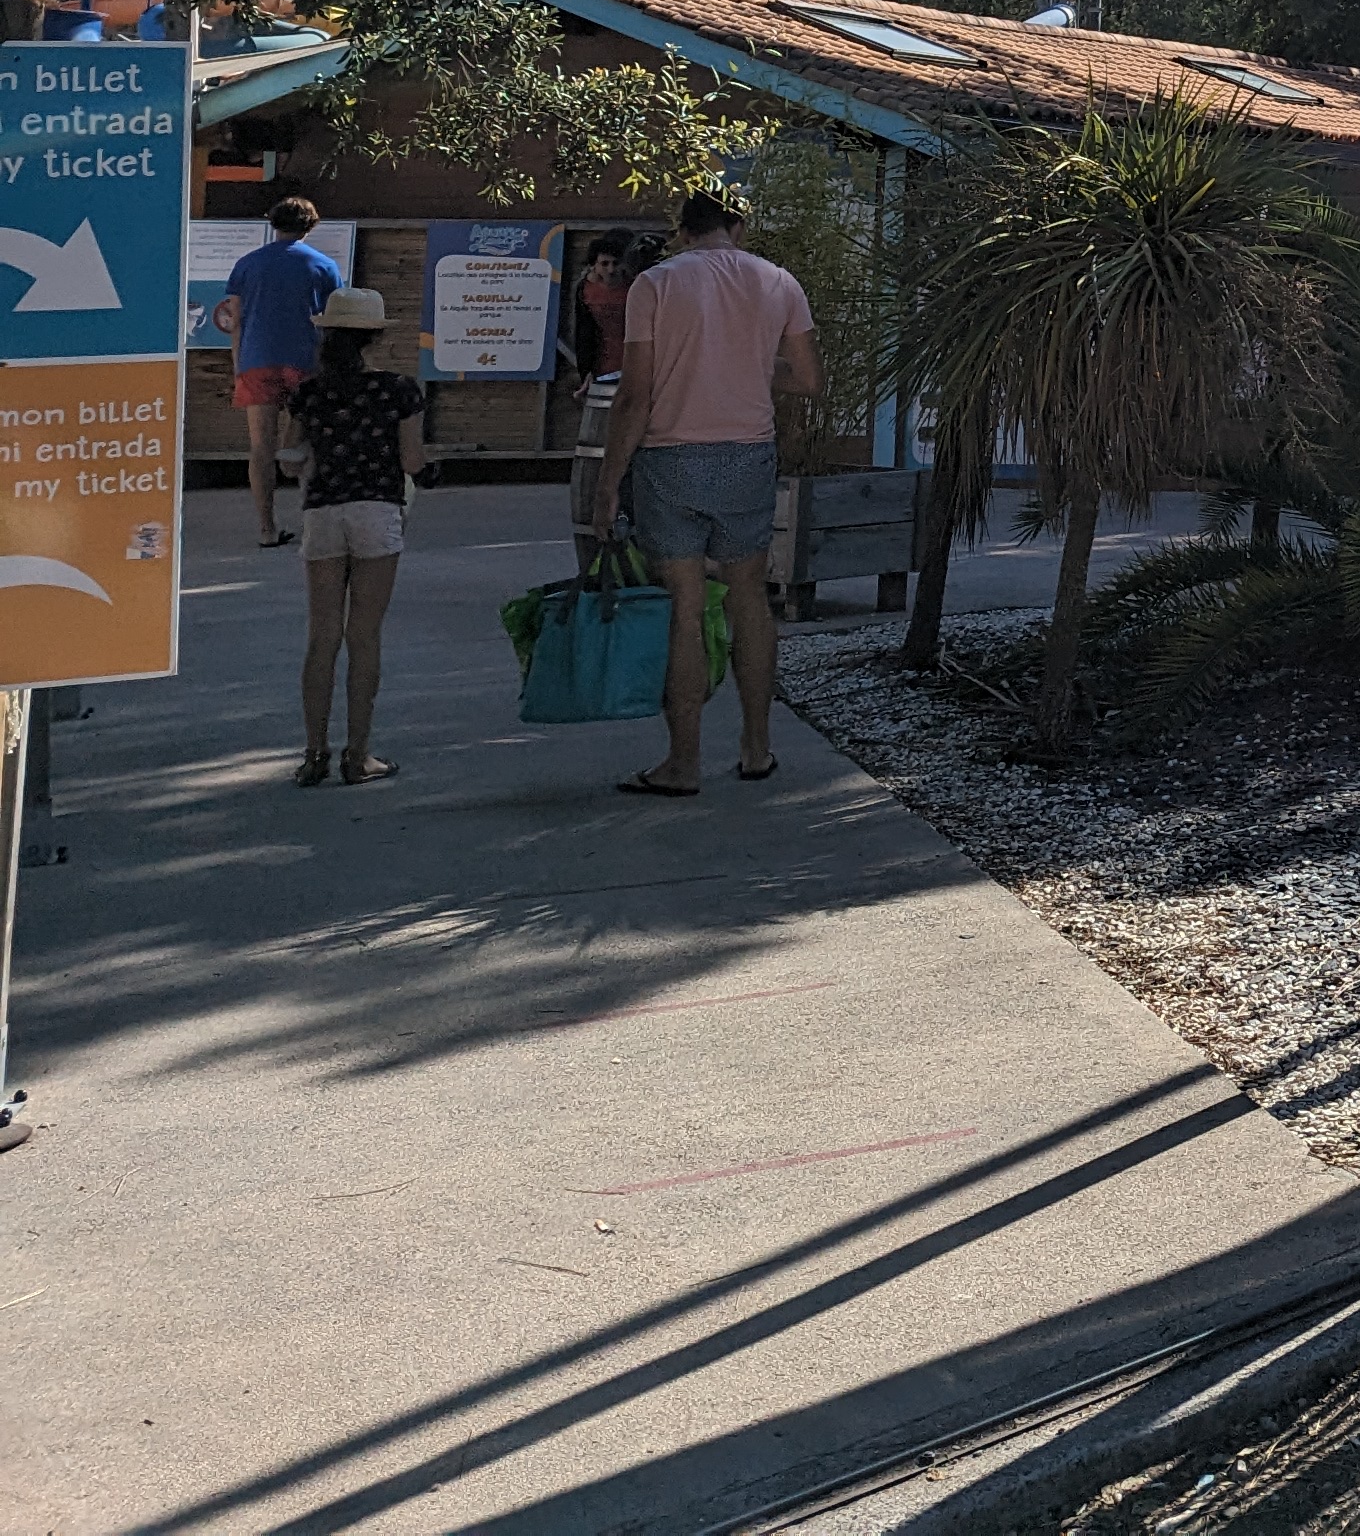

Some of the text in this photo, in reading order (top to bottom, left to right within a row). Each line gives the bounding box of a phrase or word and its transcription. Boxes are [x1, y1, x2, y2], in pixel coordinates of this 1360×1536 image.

[21, 105, 173, 136] entrada
[0, 148, 156, 184] y ticket
[36, 433, 161, 463] entrada
[14, 466, 169, 502] my ticket
